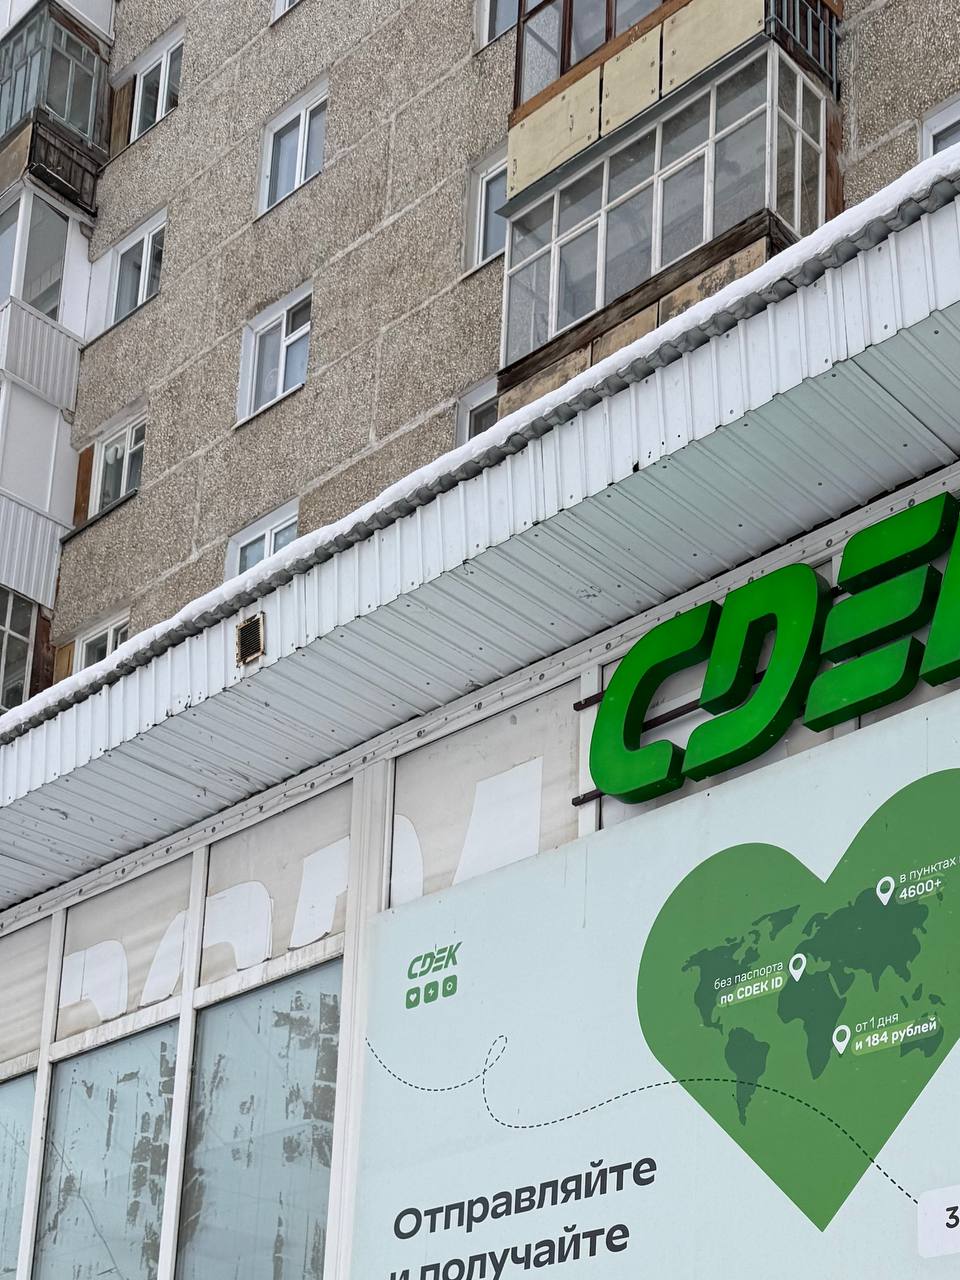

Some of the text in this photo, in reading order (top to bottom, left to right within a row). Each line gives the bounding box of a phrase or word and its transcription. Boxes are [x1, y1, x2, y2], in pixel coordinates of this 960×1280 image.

[899, 873, 907, 883] в
[908, 857, 958, 883] пунктах
[899, 877, 942, 900] 4600+
[407, 941, 463, 980] CDEK
[713, 961, 784, 990] без паспорта
[719, 976, 784, 1005] по CDEK ID
[855, 1013, 900, 1033] от 1 дня
[855, 1017, 937, 1051] и 184 рублей
[393, 1157, 657, 1240] Отправляйте
